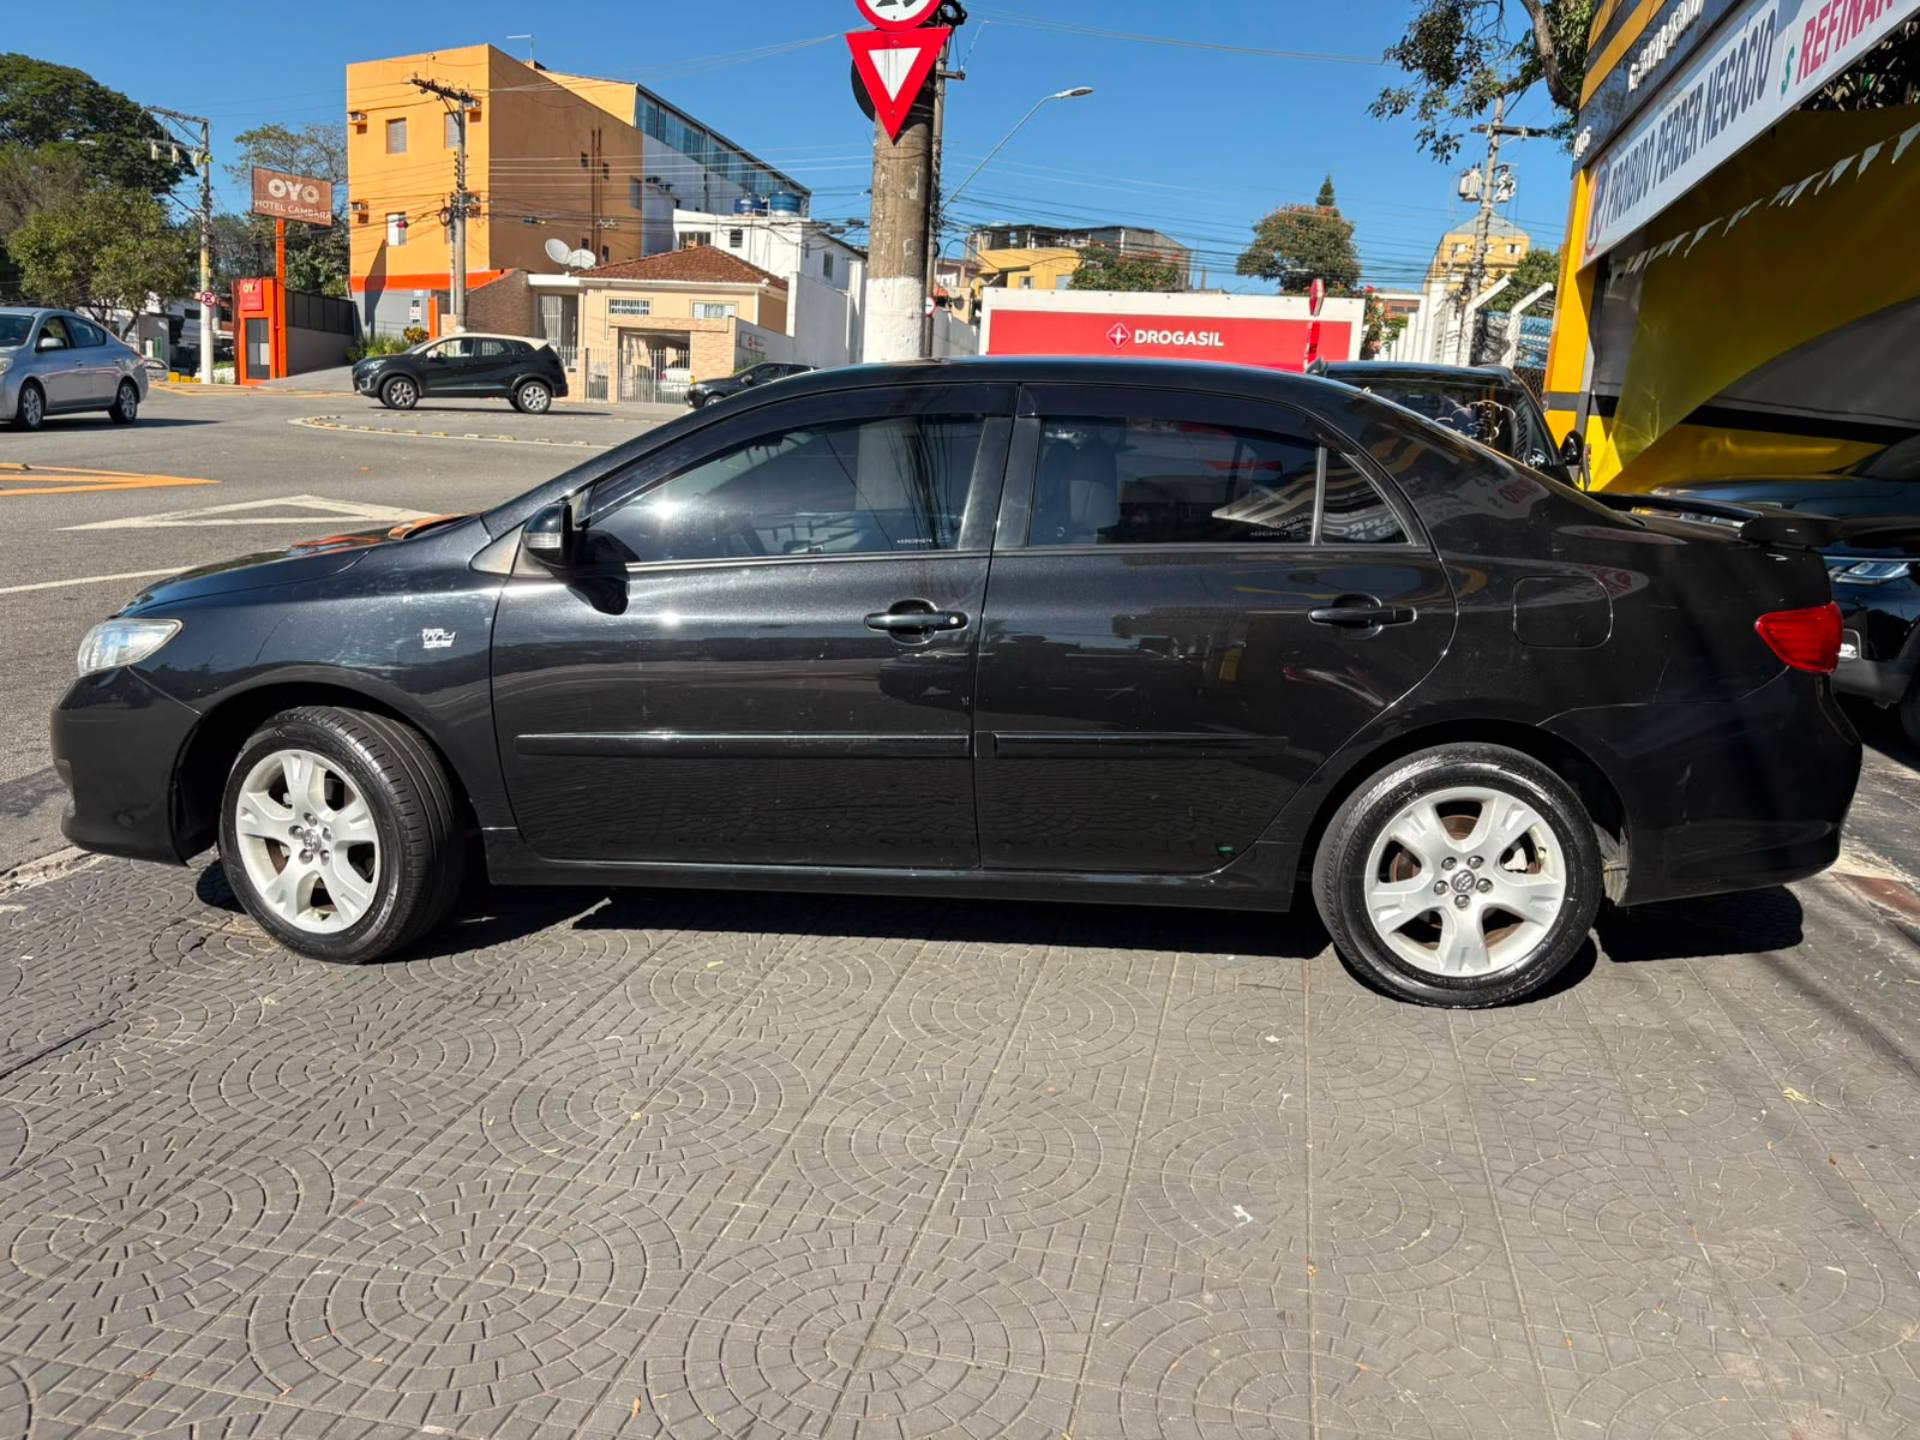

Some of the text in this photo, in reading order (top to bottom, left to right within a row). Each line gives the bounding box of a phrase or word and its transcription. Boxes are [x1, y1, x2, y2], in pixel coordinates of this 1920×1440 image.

[1605, 129, 1656, 229] PROIBIDO
[1652, 82, 1704, 190] PERDER
[1700, 9, 1777, 149] NEGÓCIO
[268, 178, 320, 205] OYO
[255, 200, 286, 212] HOTEL
[1134, 329, 1225, 347] DROGASIL
